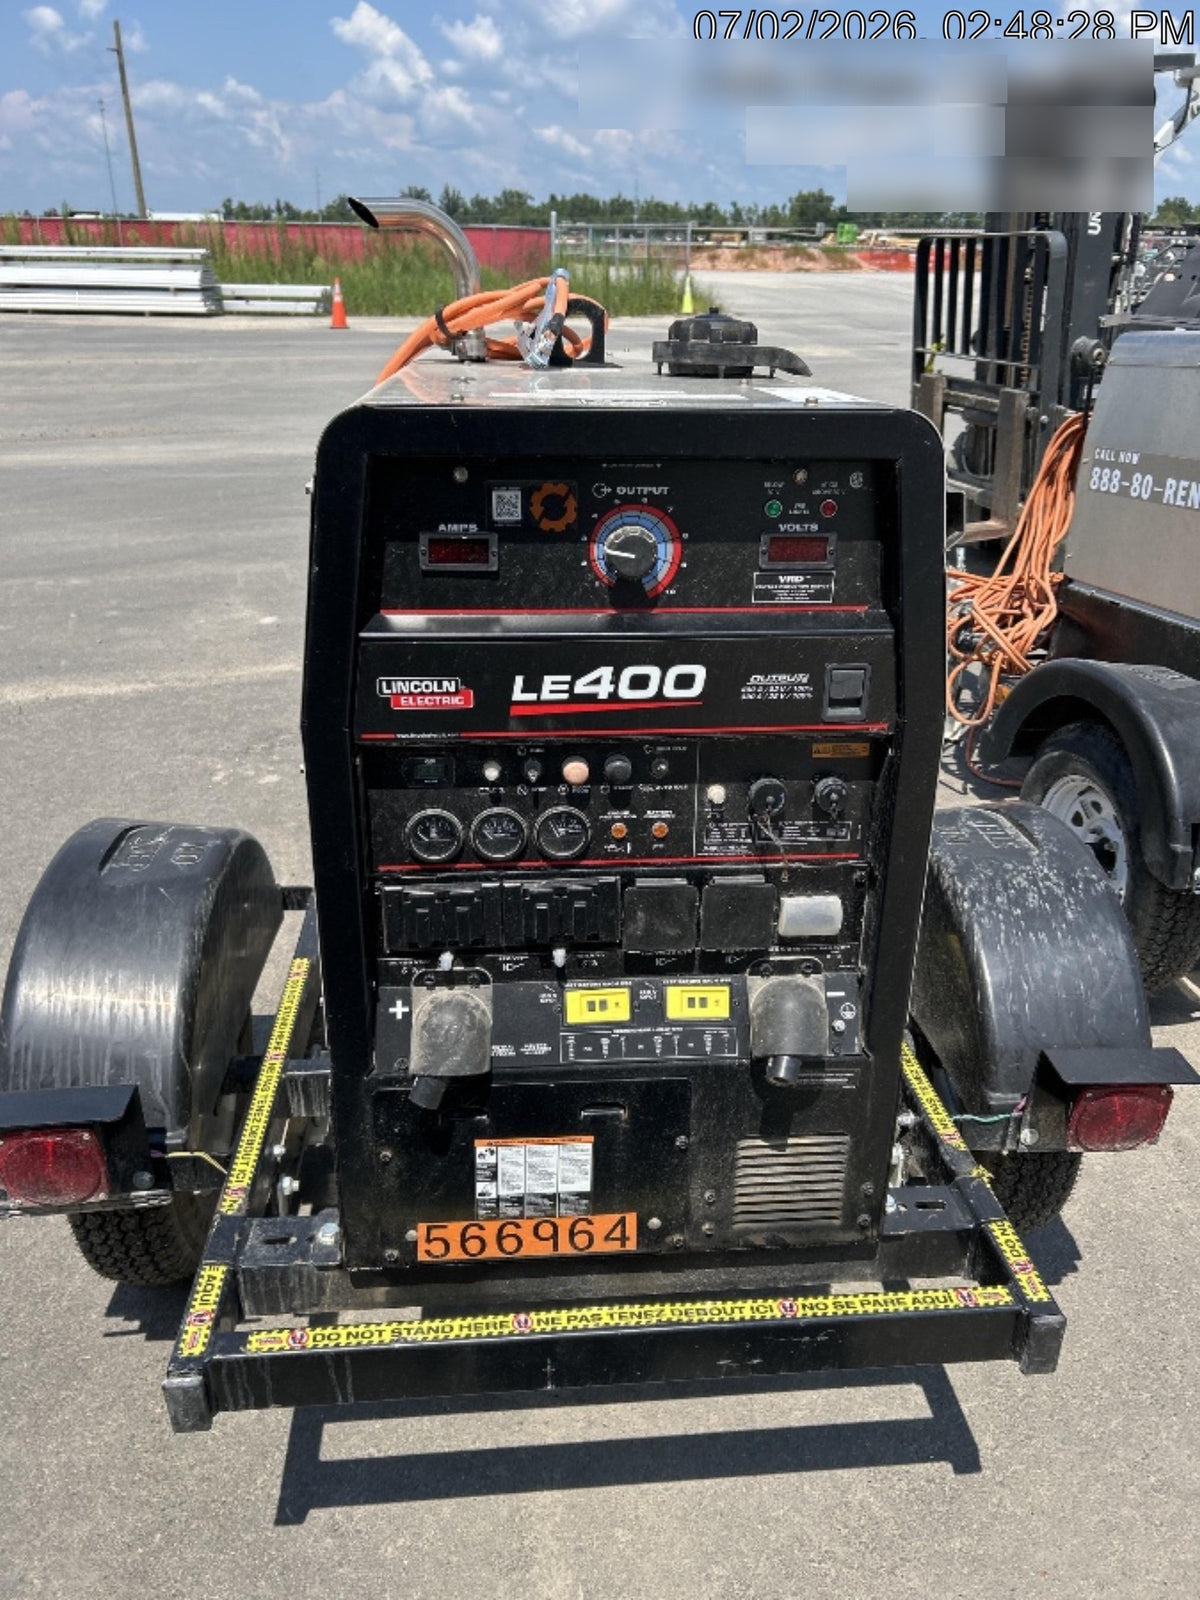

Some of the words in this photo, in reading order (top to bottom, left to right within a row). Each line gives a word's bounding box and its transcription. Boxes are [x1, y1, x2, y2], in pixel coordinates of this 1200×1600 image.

[1094, 447, 1116, 461] CALL
[1118, 451, 1141, 464] NOW
[616, 486, 669, 495] OUTPUT
[438, 523, 479, 533] AMPS
[778, 522, 819, 533] VOLTS
[381, 679, 457, 695] LINCOLN
[511, 664, 707, 702] LE400
[400, 695, 465, 706] ELECTRIC
[423, 1215, 631, 1260] 566964
[312, 1332, 341, 1343] DO
[346, 1329, 387, 1341] NOT
[390, 1323, 455, 1338] STAND
[459, 1320, 511, 1333] HERE
[536, 1316, 563, 1327] NE
[566, 1313, 603, 1325] PAS
[608, 1309, 663, 1322] TENEZ
[671, 1305, 746, 1317] DEBOUT
[750, 1304, 774, 1315] ICI
[801, 1301, 829, 1312] NO
[831, 1300, 857, 1310] SE
[860, 1297, 905, 1309] PARE
